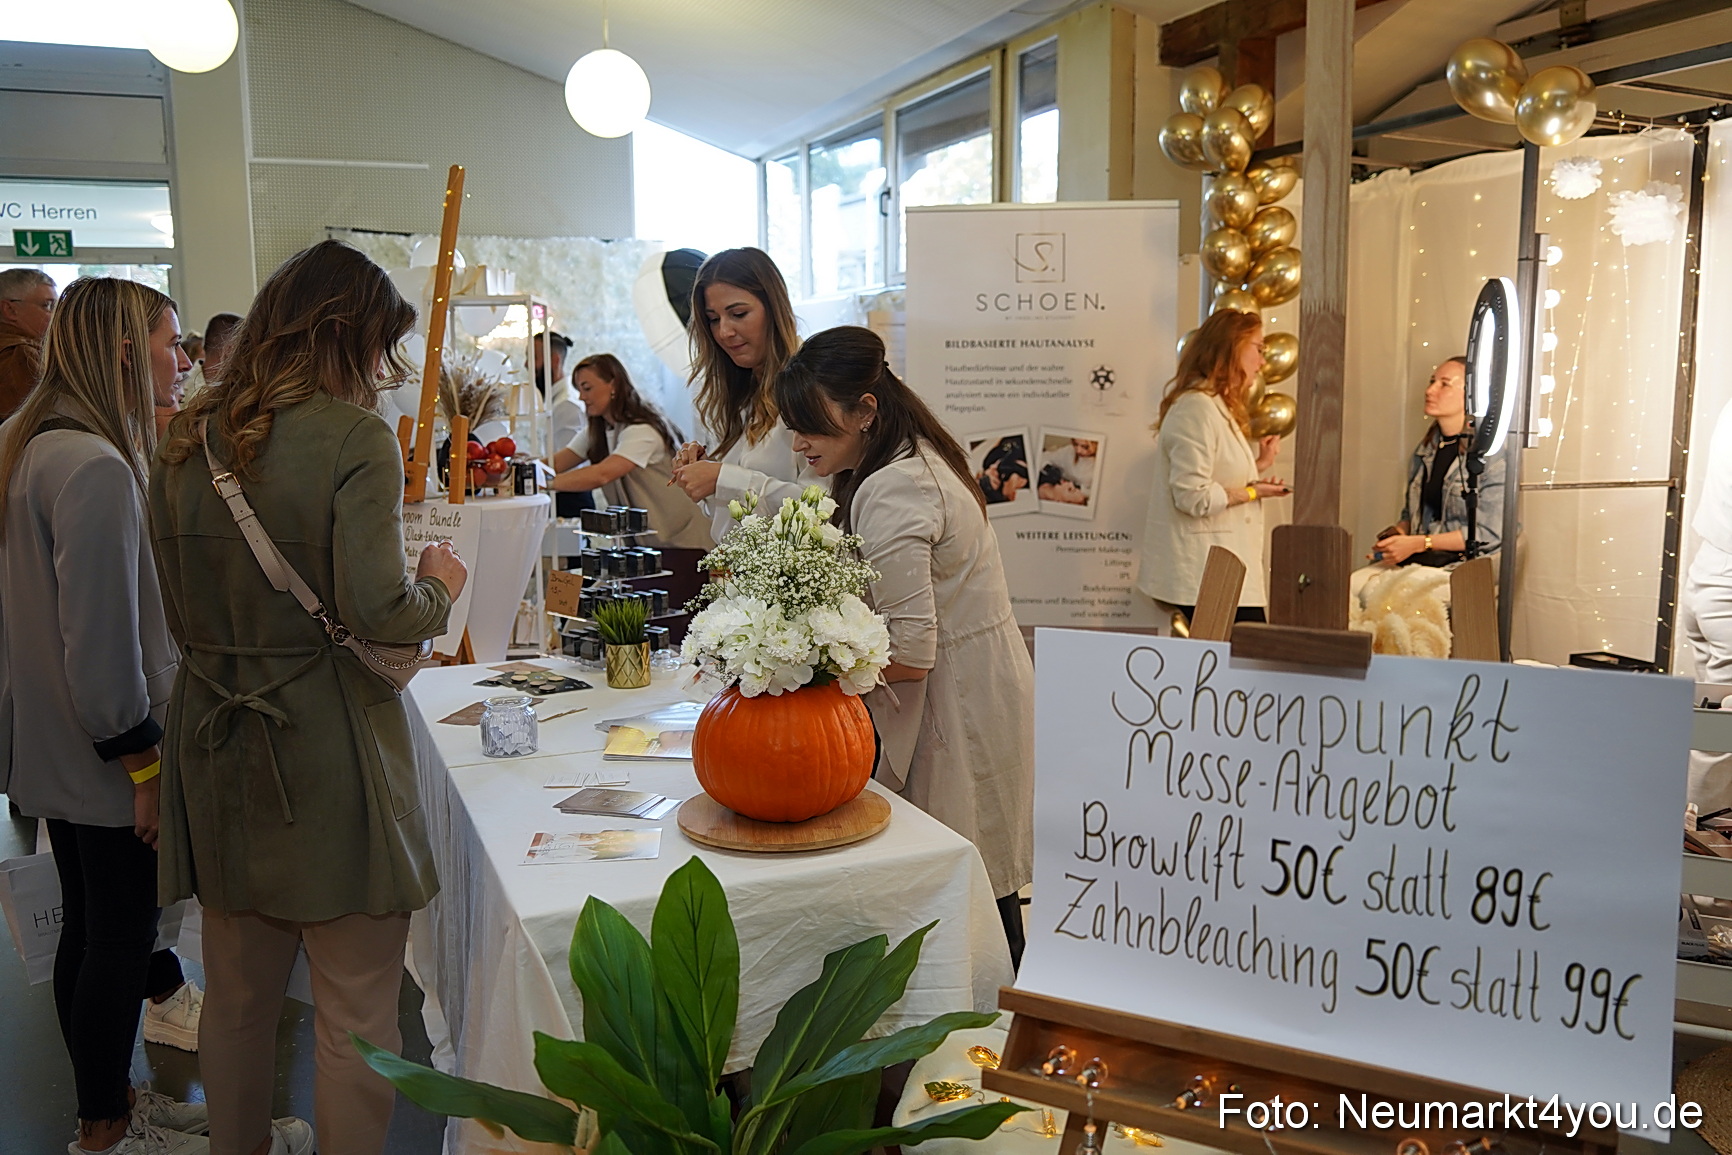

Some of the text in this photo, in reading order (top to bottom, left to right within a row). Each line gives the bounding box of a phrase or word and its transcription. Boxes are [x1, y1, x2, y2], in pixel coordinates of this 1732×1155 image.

[31, 203, 97, 220] Herren
[976, 292, 1106, 312] SCHOEN.
[945, 338, 1095, 349] BILDBASIERTE HAUTANALYSE
[1008, 364, 1024, 373] und
[1026, 363, 1039, 372] der
[945, 378, 994, 386] Hautzustand
[945, 391, 981, 400] analysiert
[1022, 391, 1071, 399] individueller
[429, 507, 462, 527] Bundle
[1015, 531, 1059, 540] WEITERE
[1055, 546, 1096, 554] Permanent
[1104, 559, 1132, 568] Liftings
[1045, 597, 1060, 605] und
[1111, 645, 1519, 774] Schoenpunkt
[1125, 728, 1458, 842] Messe-Angebot
[1073, 801, 1554, 932] Browlift 50€ statt 89€
[1054, 872, 1644, 1041] Zahnbleaching 50€ statt 99€
